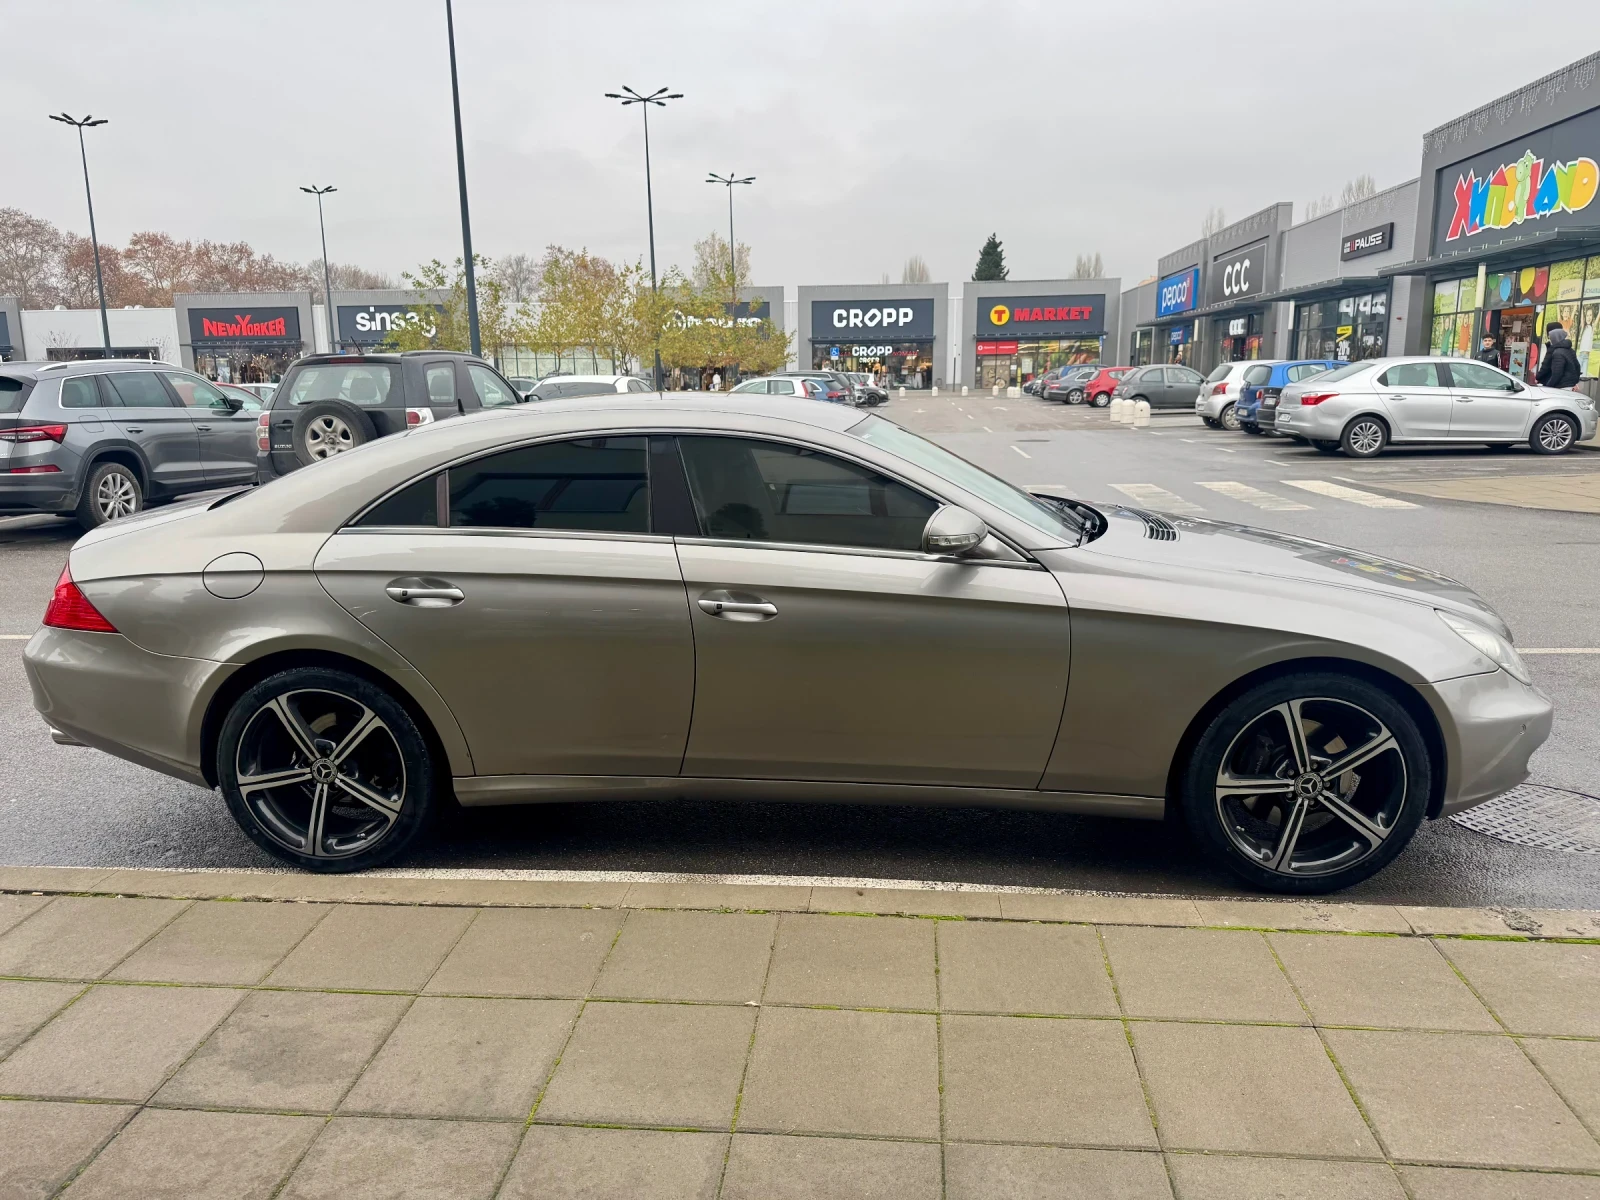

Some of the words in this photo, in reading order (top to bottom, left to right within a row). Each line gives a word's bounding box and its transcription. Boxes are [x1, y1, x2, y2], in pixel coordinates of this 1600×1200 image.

[1354, 231, 1383, 251] PAUSE
[1223, 258, 1251, 297] CCC
[1161, 280, 1188, 313] pepco
[833, 307, 914, 328] CROPP
[1014, 306, 1093, 321] MARKET
[852, 345, 893, 357] CROPP
